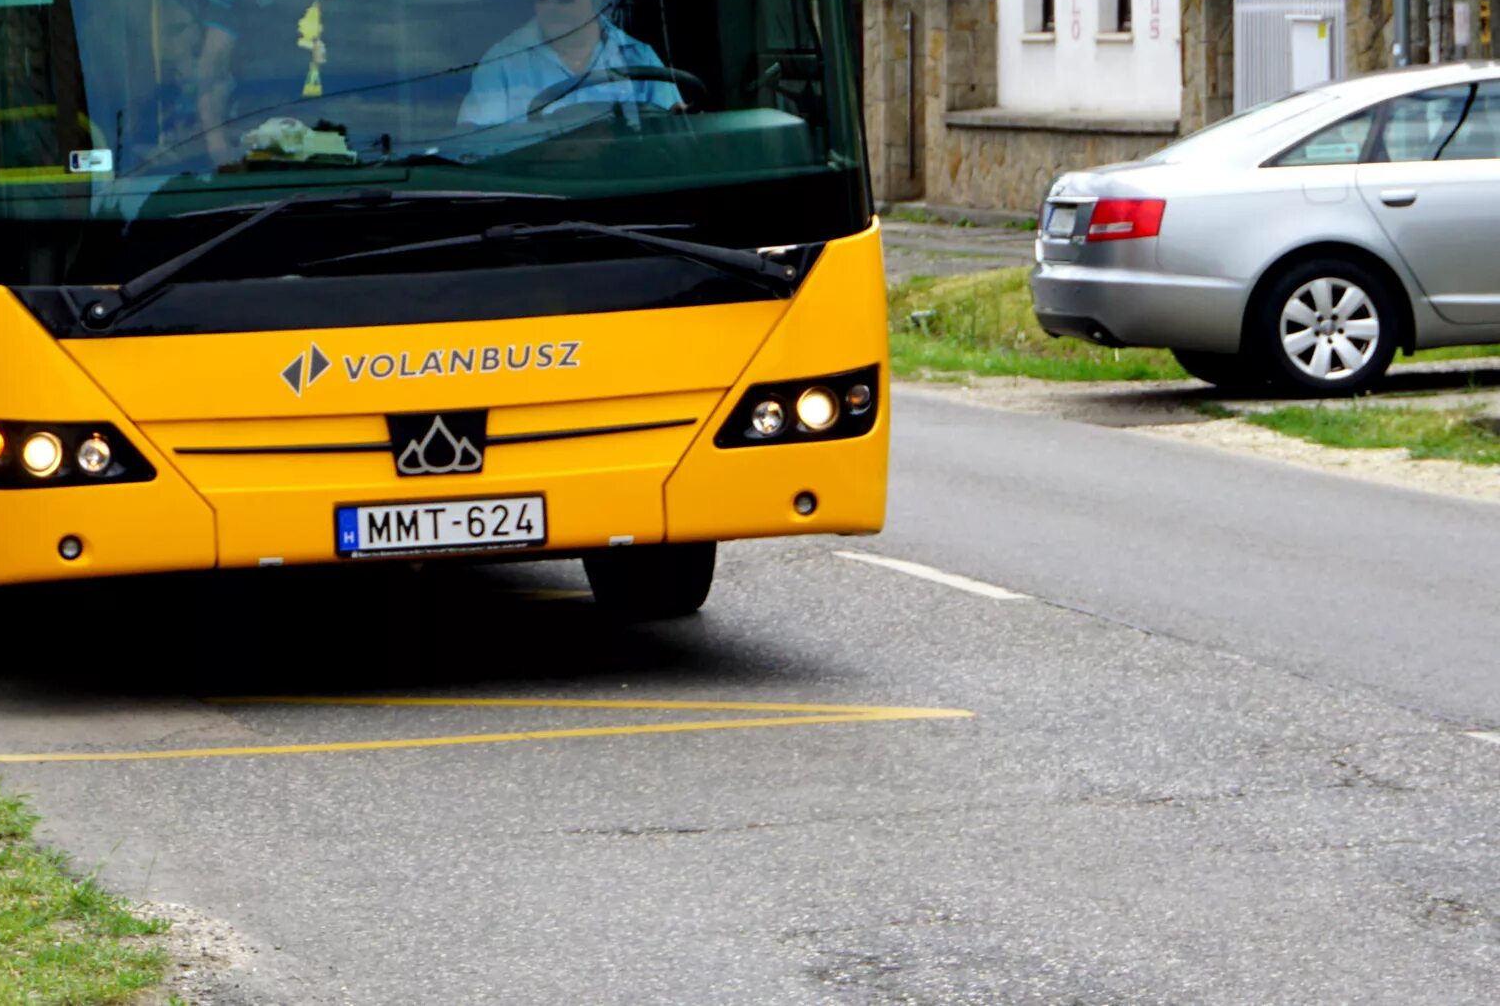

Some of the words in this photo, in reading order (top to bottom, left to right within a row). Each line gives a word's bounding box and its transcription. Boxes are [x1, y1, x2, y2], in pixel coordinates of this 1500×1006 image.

[343, 341, 583, 382] VOLÁNBUSZ
[343, 530, 356, 545] H
[367, 502, 534, 545] MMT-624
